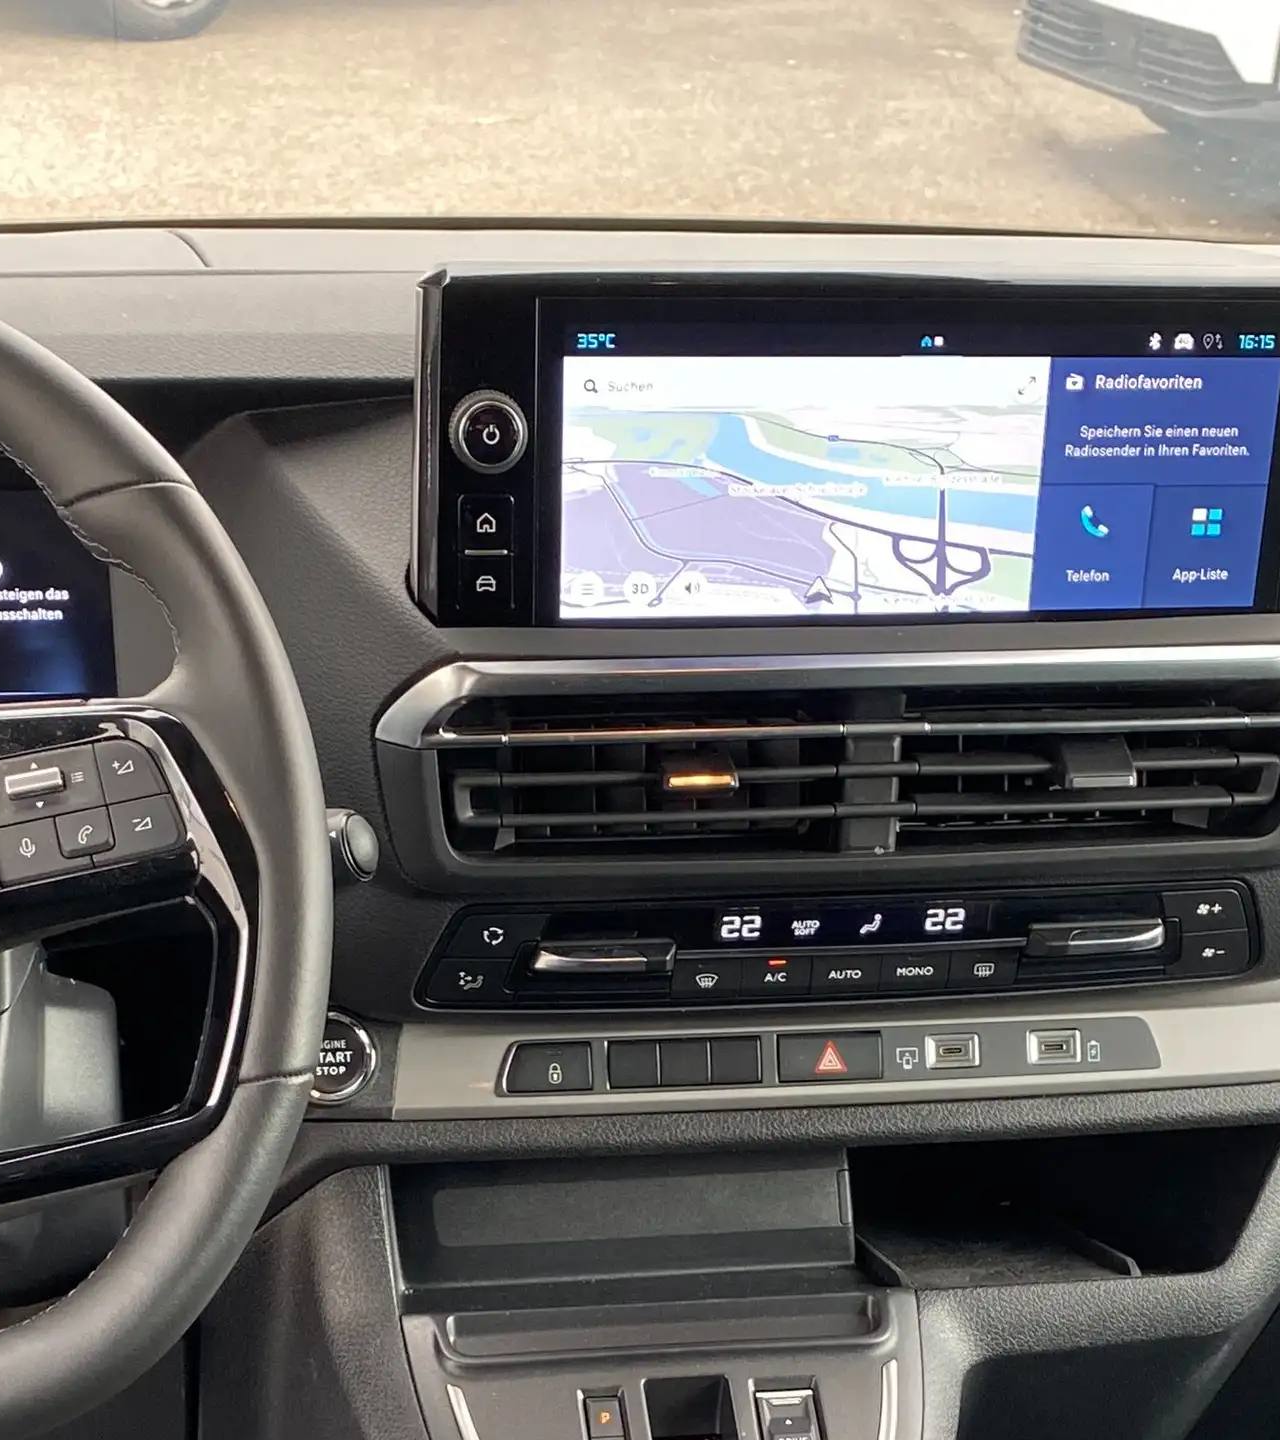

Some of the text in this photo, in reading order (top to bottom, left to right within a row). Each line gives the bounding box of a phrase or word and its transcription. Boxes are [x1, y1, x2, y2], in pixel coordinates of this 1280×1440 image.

[577, 333, 616, 349] 35°C
[1239, 334, 1276, 349] 16:15
[607, 381, 654, 393] Suchen
[1095, 374, 1203, 390] Radiofavoriten
[1080, 425, 1239, 439] Speichern Sie einen neuen
[1065, 443, 1250, 457] Radiosender in Ihren Favoriten.
[1066, 569, 1110, 583] Telefon
[1172, 567, 1229, 583] App-Liste
[45, 587, 70, 600] das
[631, 583, 650, 595] 3D
[791, 920, 820, 929] AUTO
[924, 908, 966, 931] 22
[720, 915, 762, 939] 22
[794, 928, 815, 936] SOFT
[764, 972, 787, 983] A/C
[828, 970, 862, 980] AUTO
[896, 966, 934, 977] MONO
[320, 1040, 346, 1049] GINE
[319, 1051, 353, 1063] TART
[316, 1066, 346, 1076] STOP
[600, 1411, 610, 1424] P
